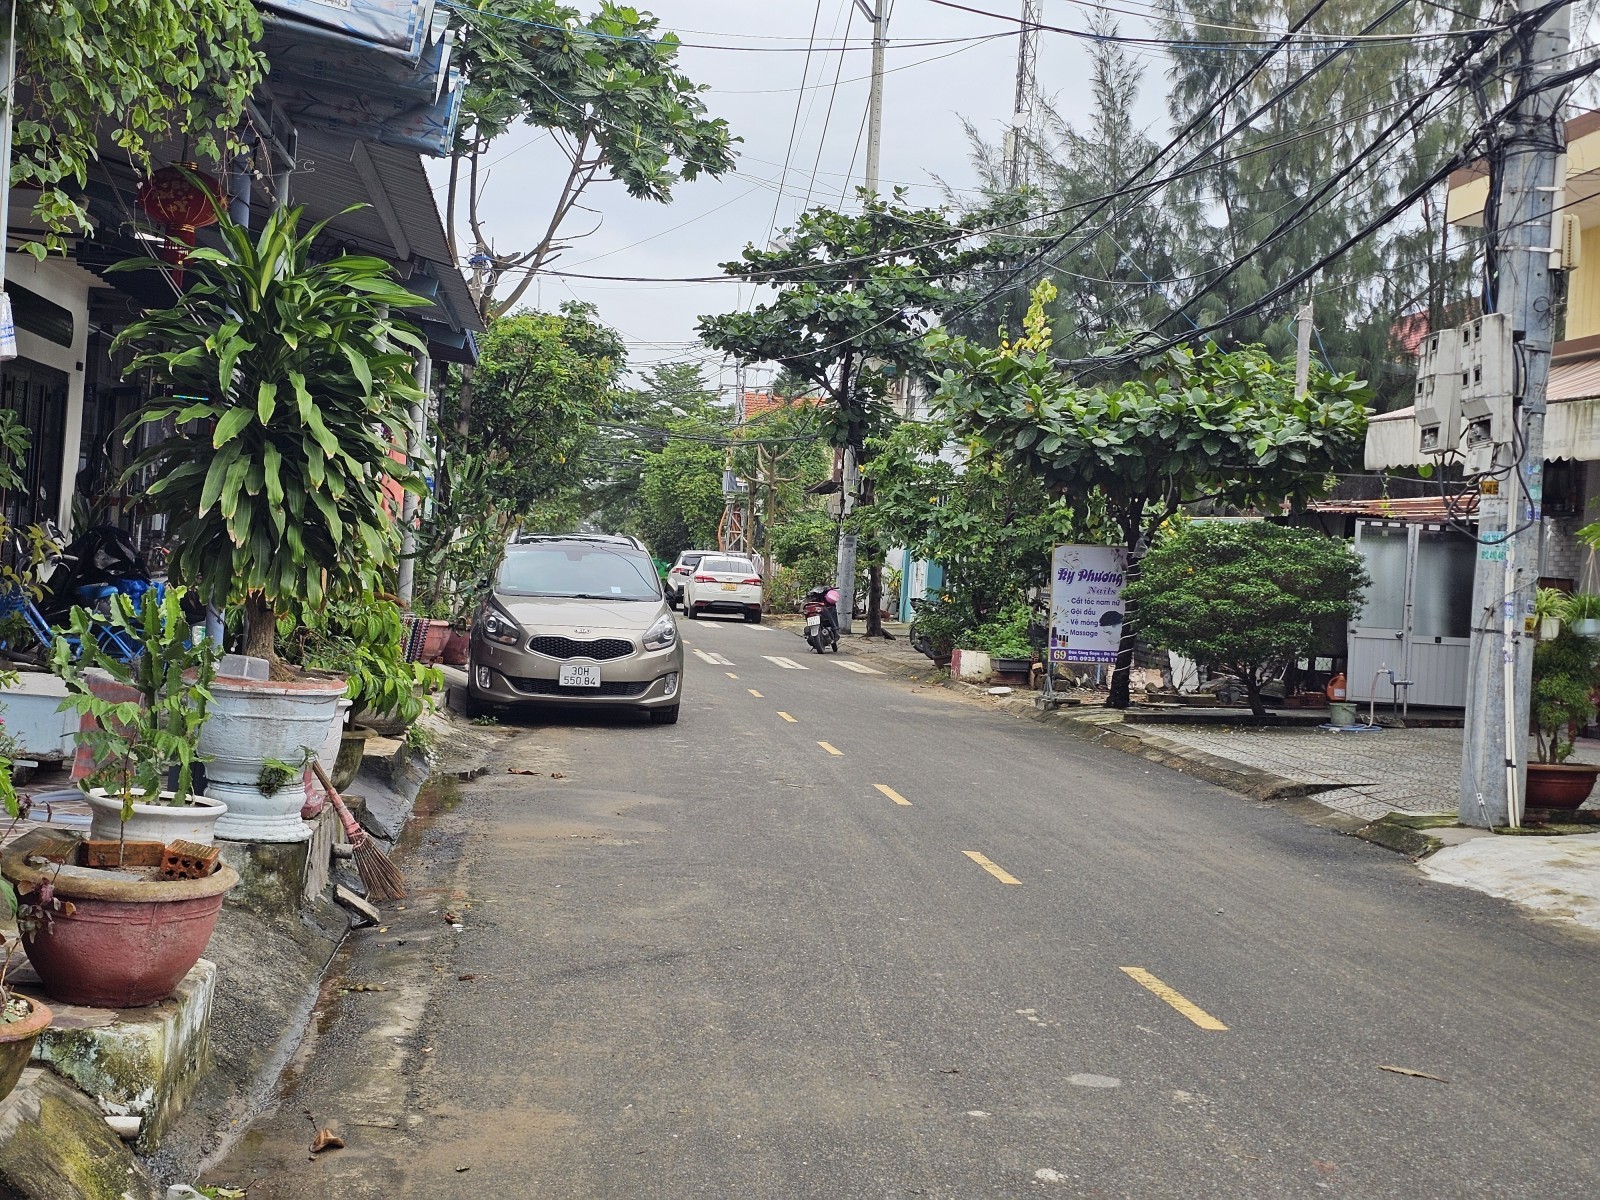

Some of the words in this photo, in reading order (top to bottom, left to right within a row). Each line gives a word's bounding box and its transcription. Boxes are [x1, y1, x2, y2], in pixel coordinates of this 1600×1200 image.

[1078, 568, 1123, 587] Phương
[1087, 586, 1116, 595] Nails
[1084, 598, 1095, 606] tóc
[1081, 619, 1098, 627] móng
[1070, 629, 1098, 638] Massage
[1053, 650, 1067, 660] 69
[572, 667, 590, 676] 30H
[564, 676, 596, 686] 550.84
